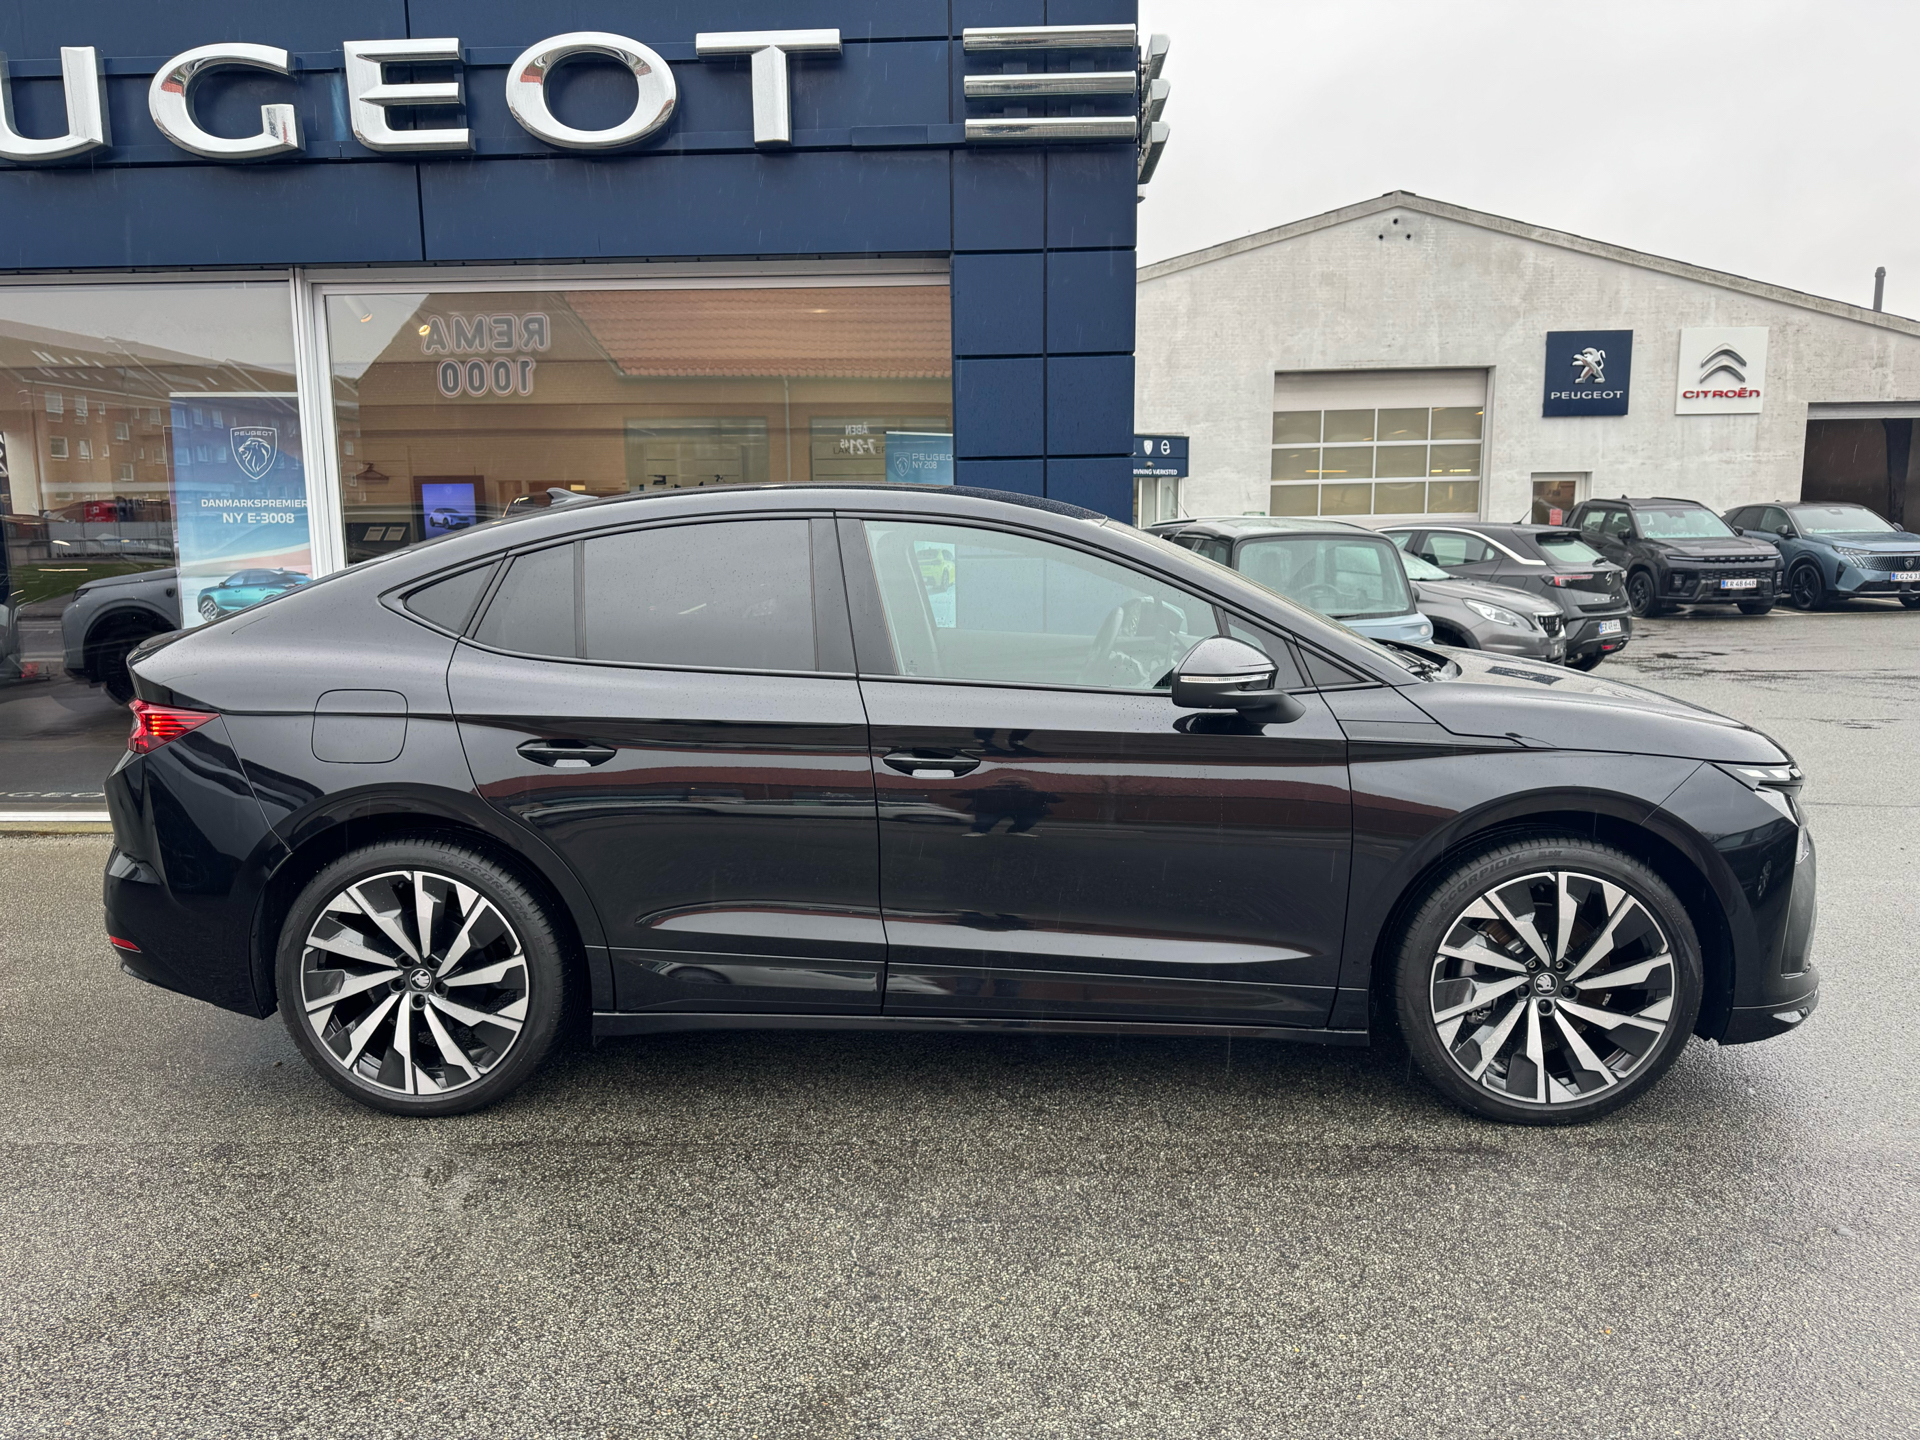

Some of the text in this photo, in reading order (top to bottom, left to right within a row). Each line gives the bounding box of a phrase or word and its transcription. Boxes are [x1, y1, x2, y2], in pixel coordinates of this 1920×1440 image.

[1551, 390, 1624, 400] PEUGEOT
[1682, 387, 1761, 400] CITROËN
[912, 461, 938, 469] NY 208
[223, 512, 295, 523] NY E-3008
[1440, 854, 1521, 911] SCORPION
